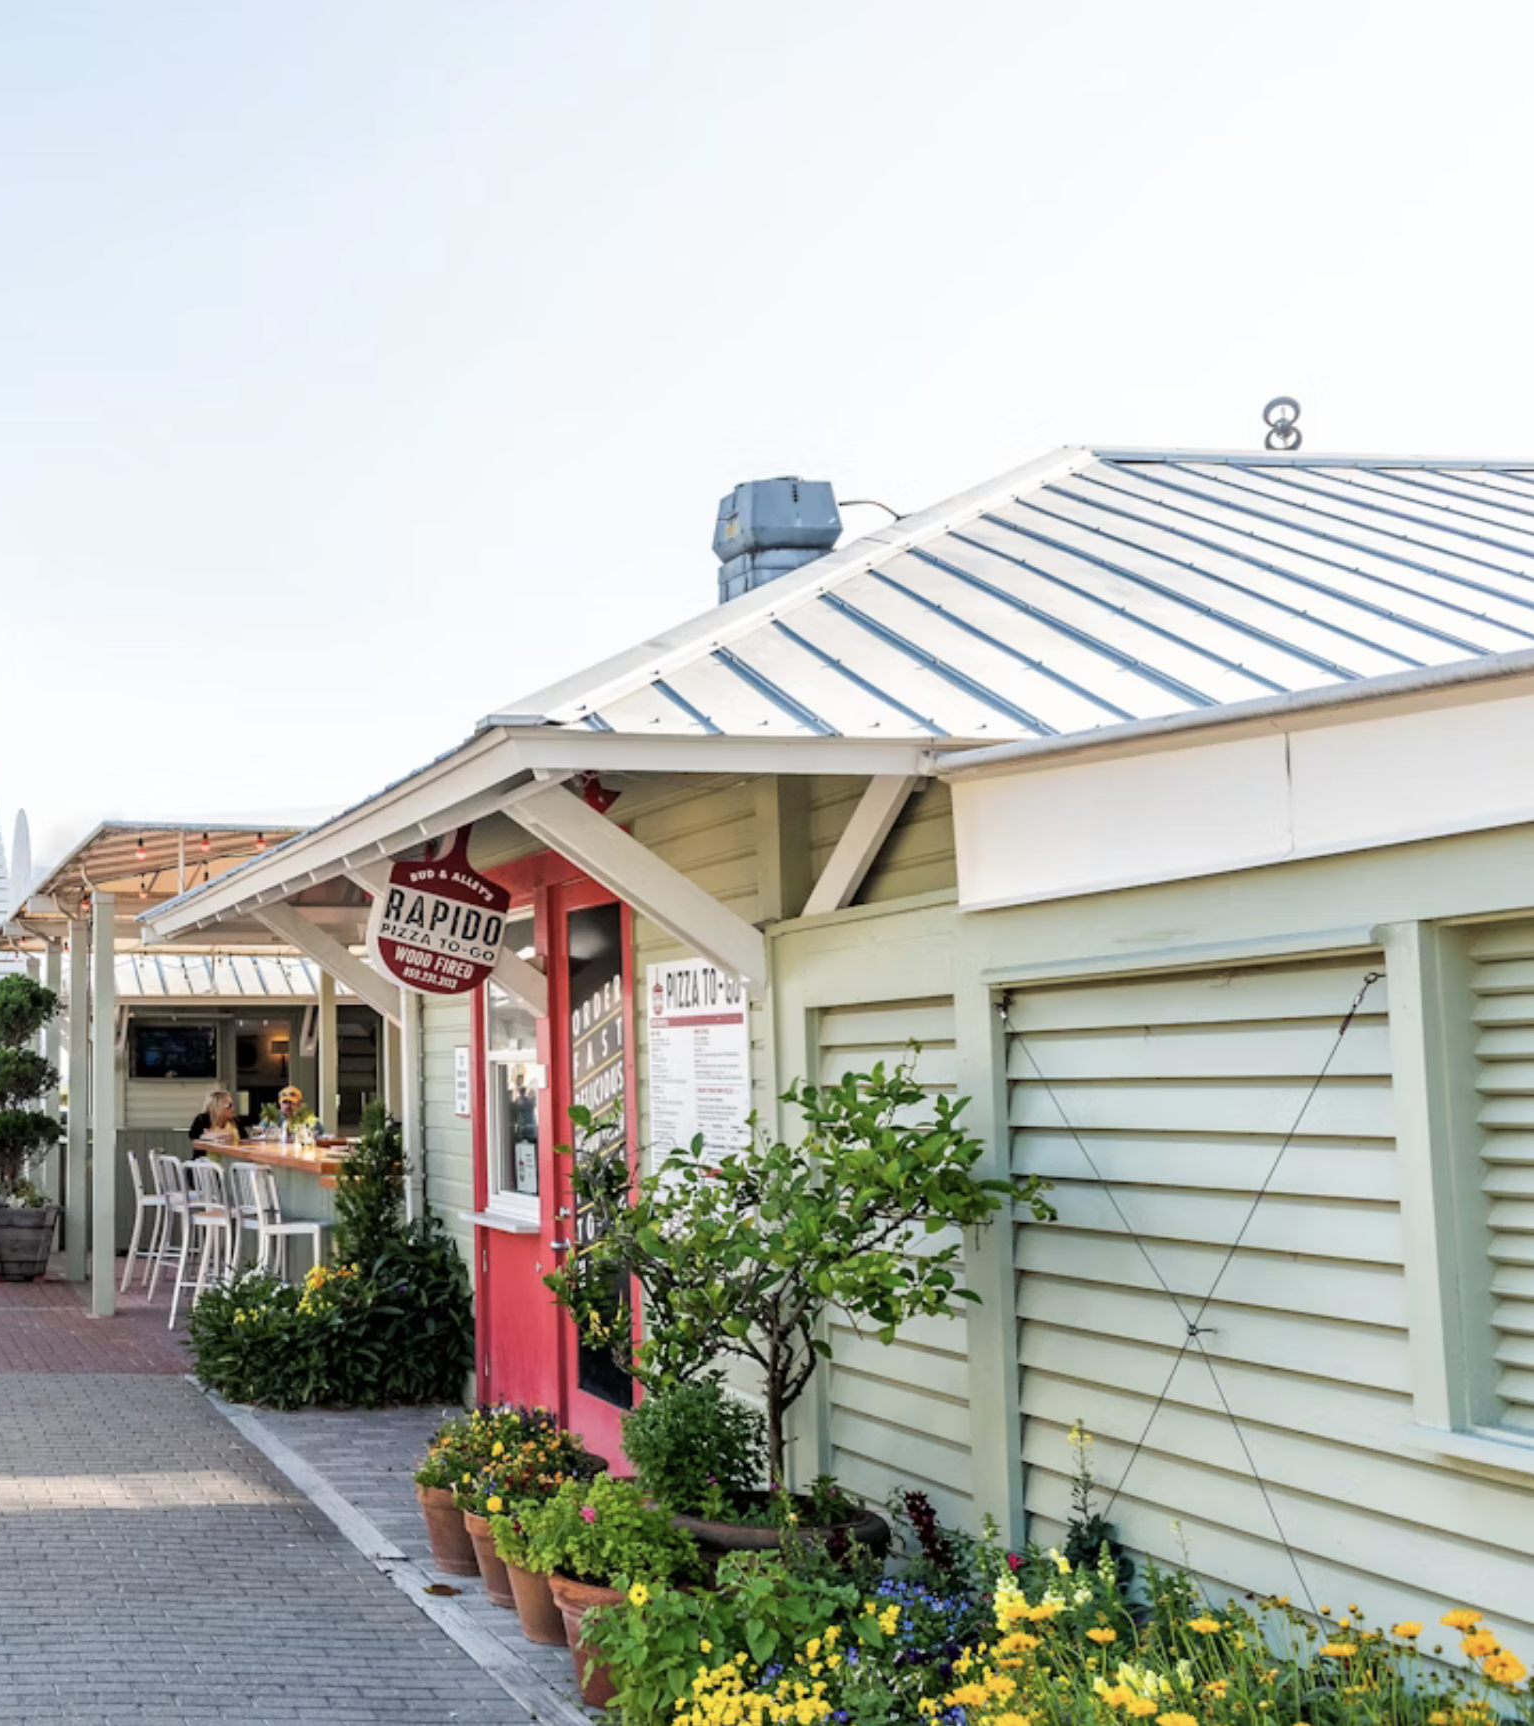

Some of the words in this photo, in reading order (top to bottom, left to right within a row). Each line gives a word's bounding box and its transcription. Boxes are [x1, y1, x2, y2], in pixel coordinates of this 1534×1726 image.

[409, 869, 435, 883] BUD
[438, 869, 448, 880] &
[384, 887, 502, 946] RAPIDO
[380, 923, 431, 946] PIZZA
[440, 938, 495, 961] TO-GO
[395, 945, 433, 969] WOOD
[434, 955, 475, 980] FIRED
[572, 973, 621, 1037] ORDER
[666, 969, 699, 1010] PIZZA
[573, 1016, 622, 1080] FAST
